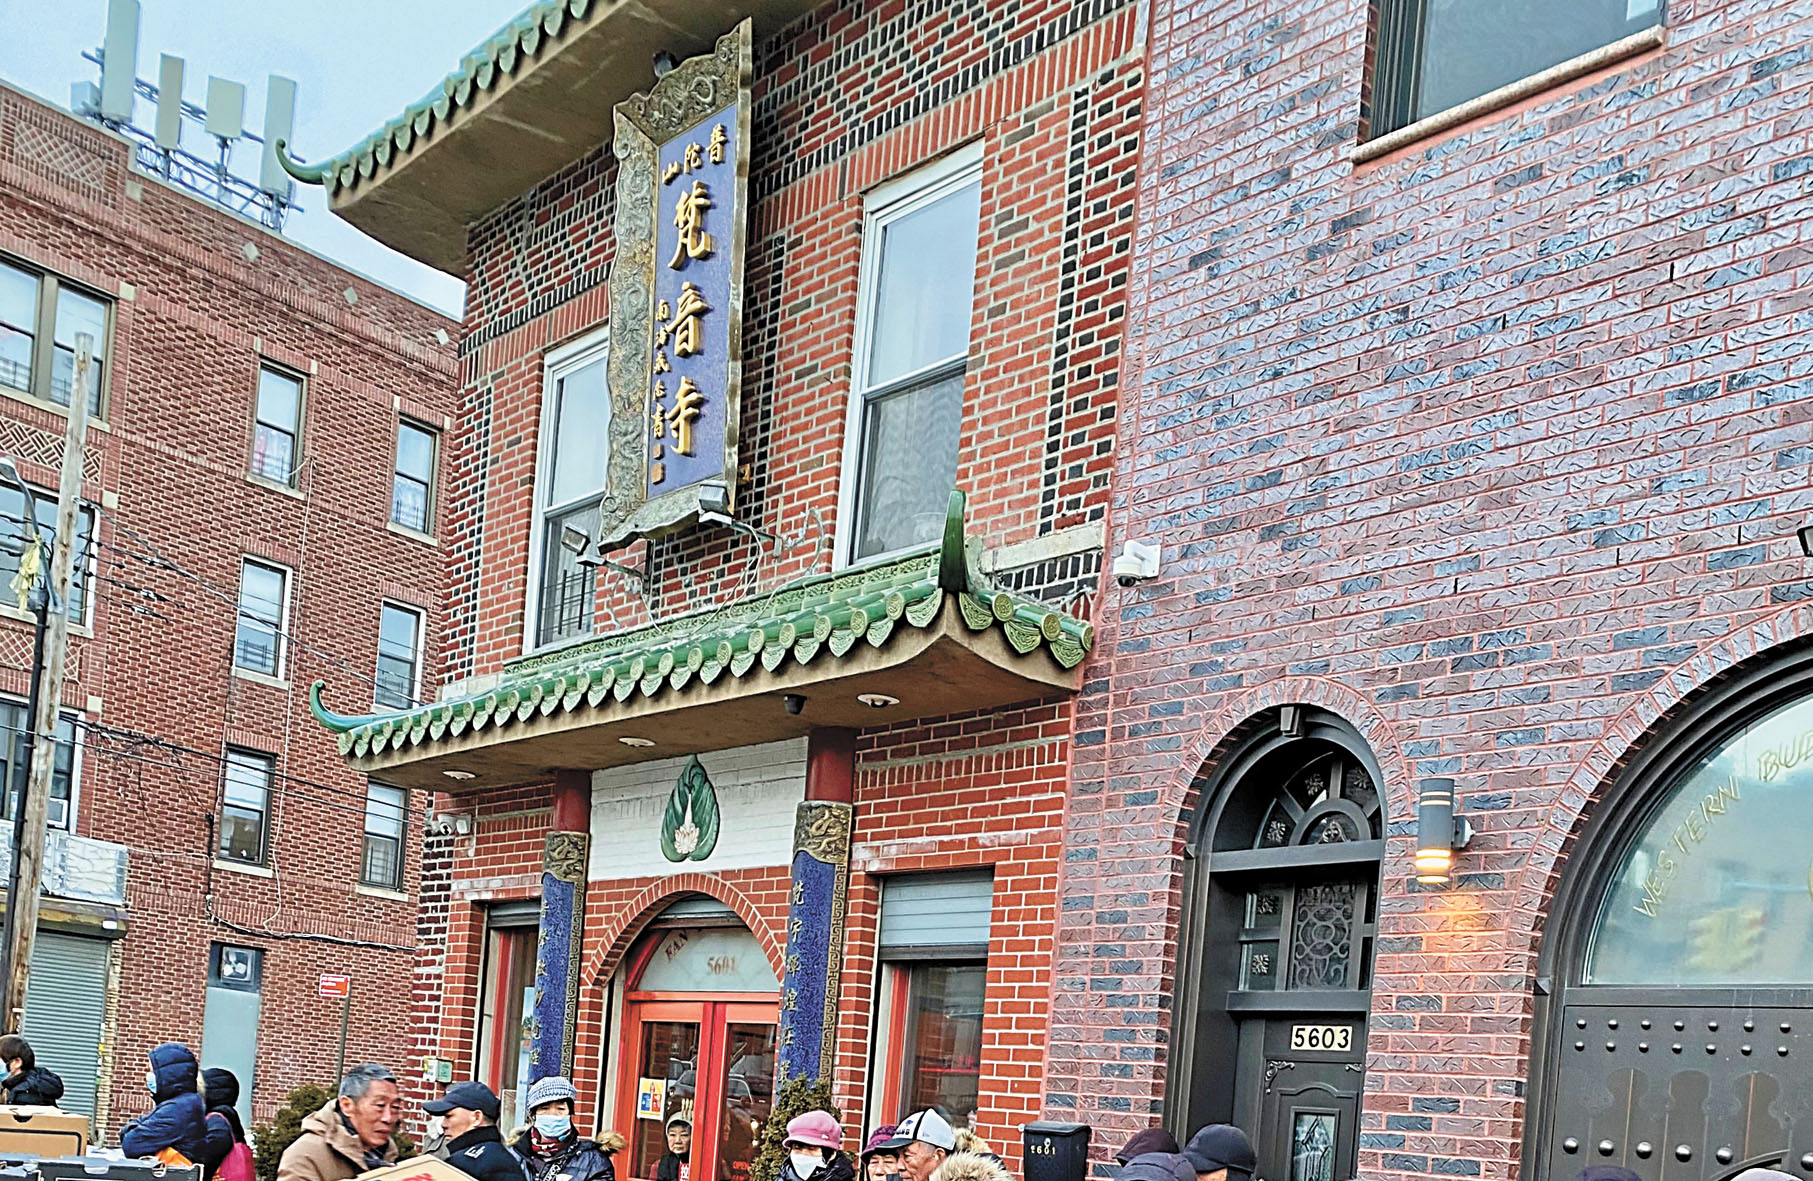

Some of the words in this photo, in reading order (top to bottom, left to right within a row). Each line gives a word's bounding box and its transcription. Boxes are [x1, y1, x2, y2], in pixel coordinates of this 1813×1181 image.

[662, 123, 727, 184] 普陀山
[666, 180, 712, 455] 梵音寺
[1633, 775, 1741, 918] WESTERN
[665, 929, 688, 961] FAN
[706, 956, 736, 976] 5601
[1293, 1027, 1349, 1049] 5603
